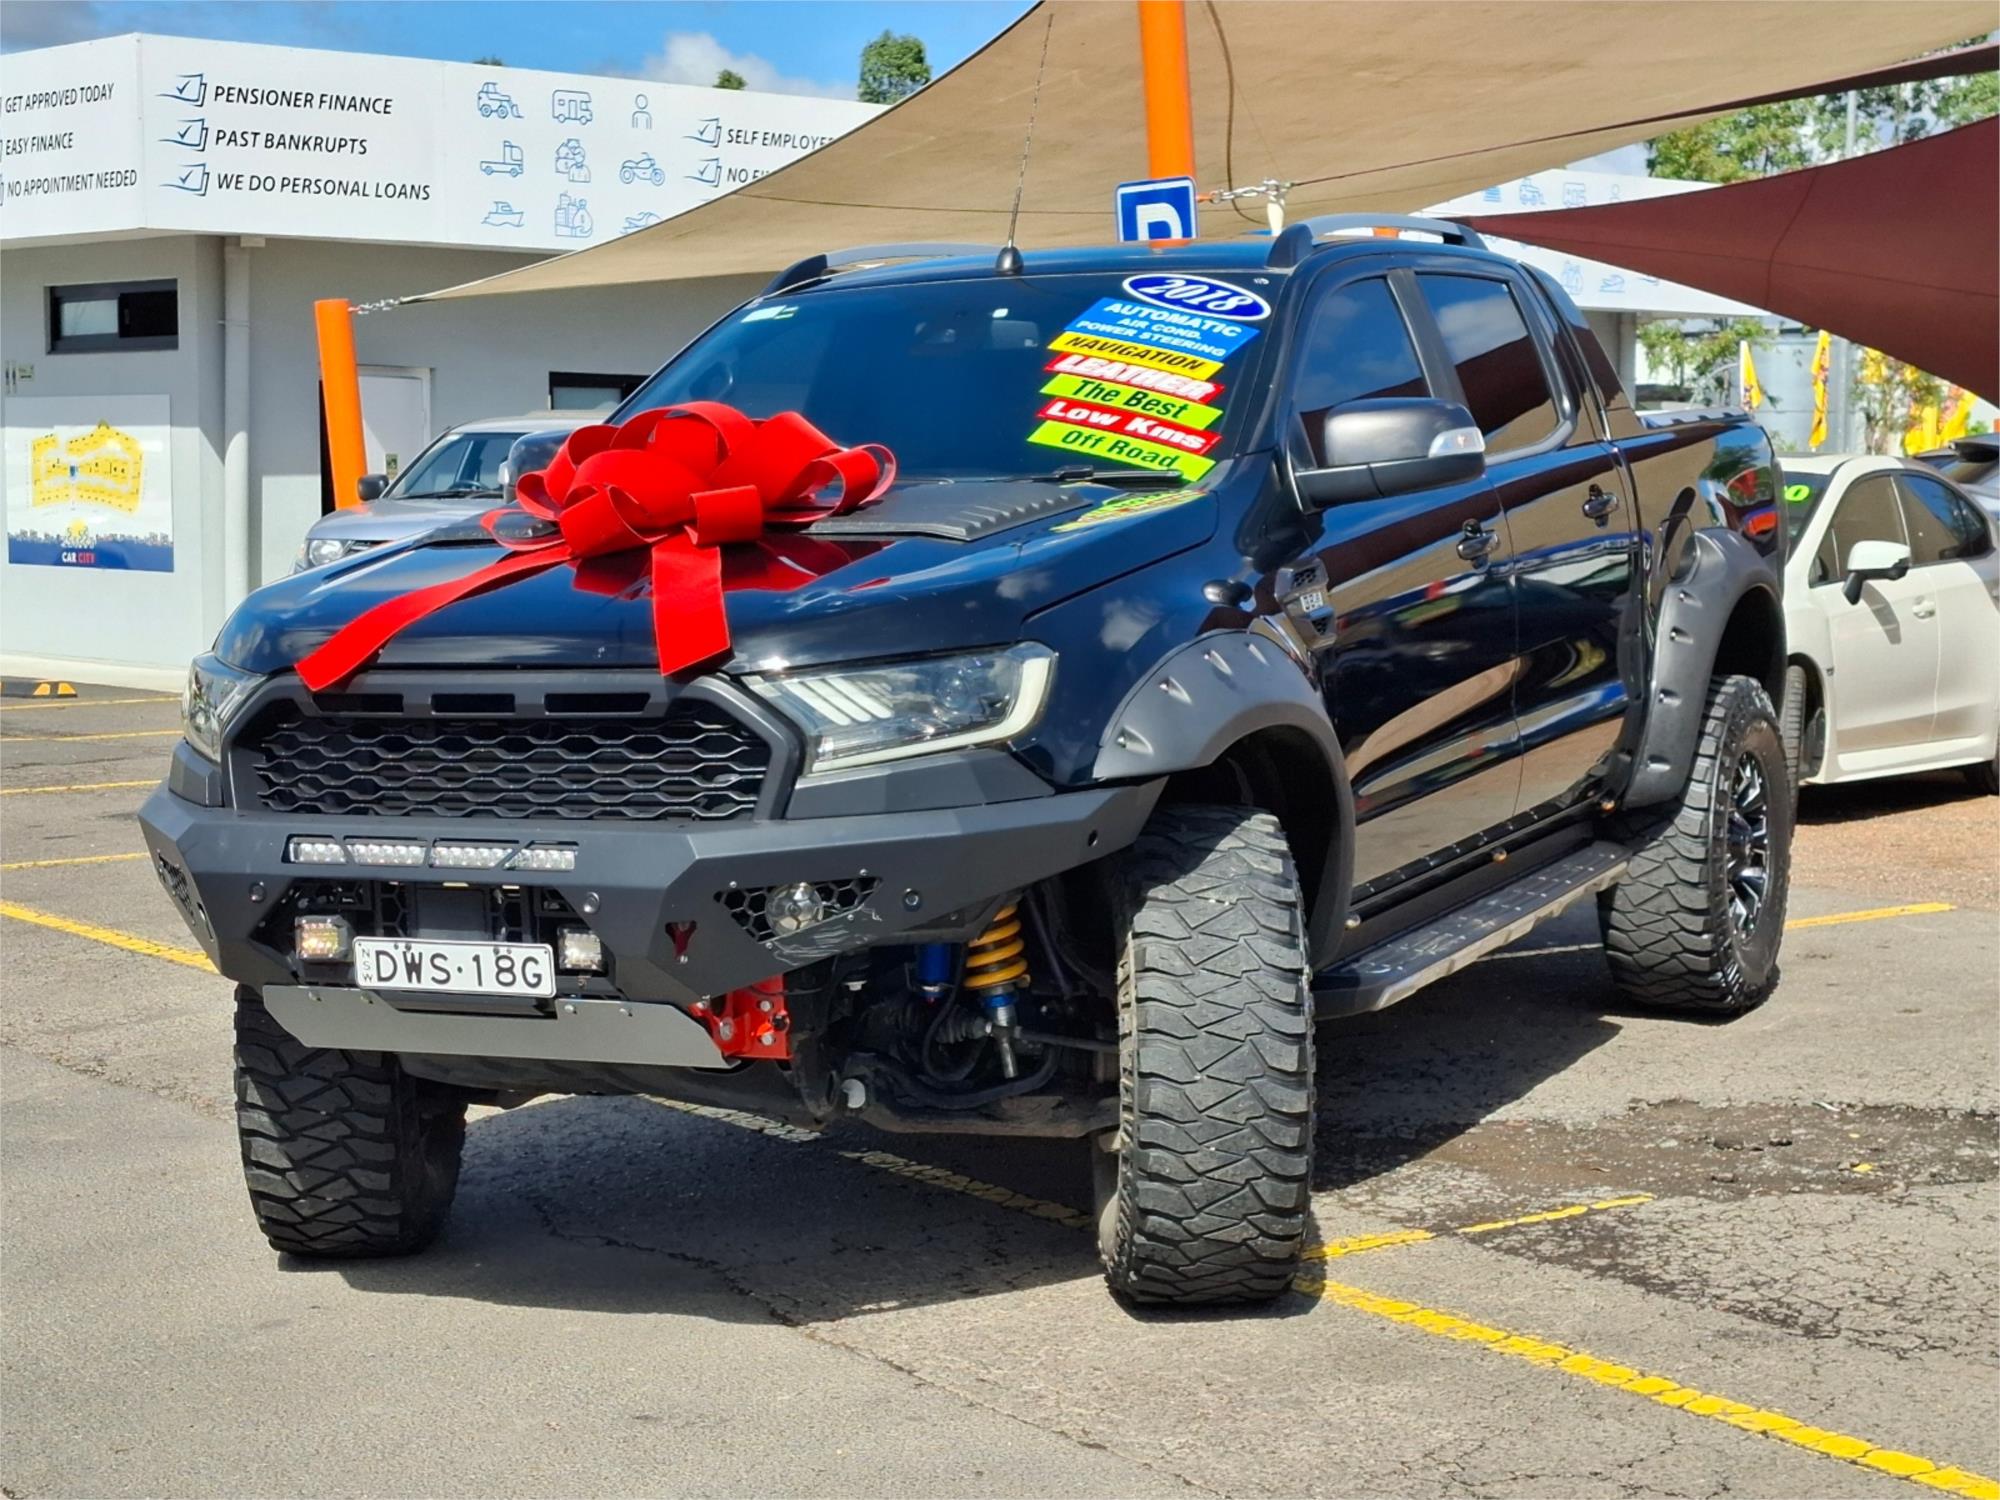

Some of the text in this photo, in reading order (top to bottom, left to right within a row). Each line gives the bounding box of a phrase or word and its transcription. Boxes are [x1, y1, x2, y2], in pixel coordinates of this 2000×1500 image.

[5, 83, 114, 113] GET APPROVED TODAY
[214, 85, 393, 115] PENSIONER FINANCE
[6, 132, 74, 156] EASY FINANCE
[215, 129, 367, 155] PAST BANKRUPTS
[727, 128, 835, 149] SELF EMPLOYE
[7, 169, 137, 197] NO APPOINTMENT NEEDED
[217, 173, 431, 201] WE DO PERSONAL LOANS
[727, 168, 748, 183] NO
[1139, 277, 1254, 312] 2018
[1104, 303, 1242, 338] AUTOMATIC
[1117, 318, 1202, 340] AIR COND.
[1065, 336, 1204, 371] NAVIGATION
[1076, 320, 1228, 357] POWER STEERING
[1053, 354, 1216, 400] LEATHER
[1072, 379, 1188, 420] The Best
[1046, 401, 1207, 450] Low Kms
[1060, 430, 1180, 468] Off Road
